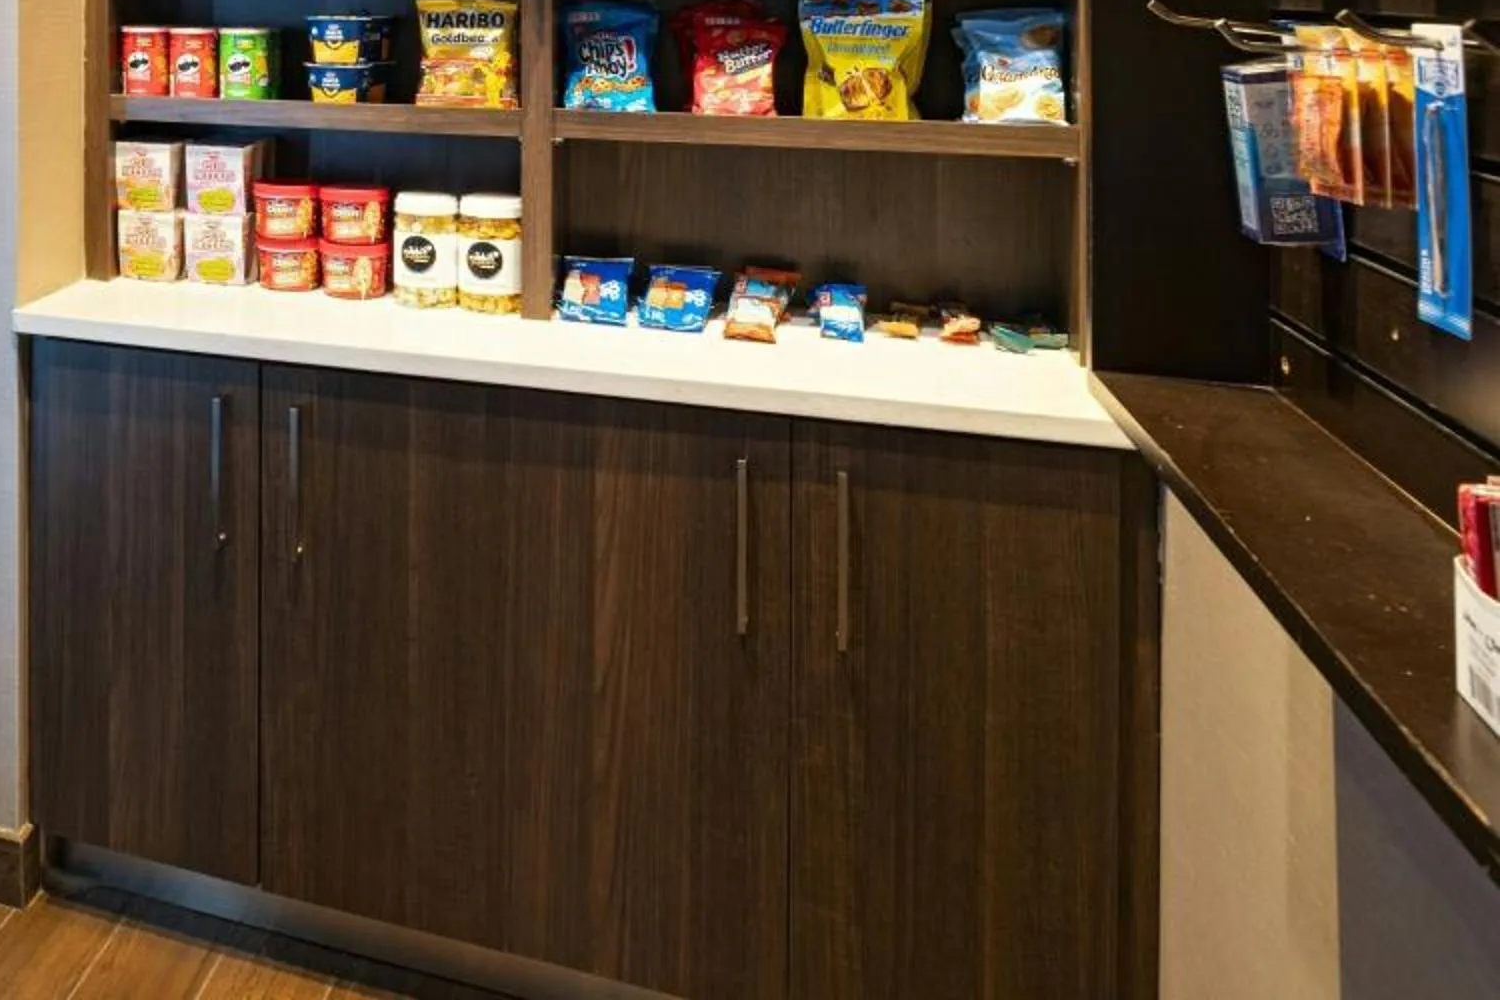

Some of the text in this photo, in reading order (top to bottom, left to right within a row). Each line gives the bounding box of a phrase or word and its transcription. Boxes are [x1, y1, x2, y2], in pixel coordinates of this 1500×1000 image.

[427, 12, 506, 29] HARIBO
[809, 16, 909, 37] Butterfinger
[431, 33, 500, 45] Goldbeas
